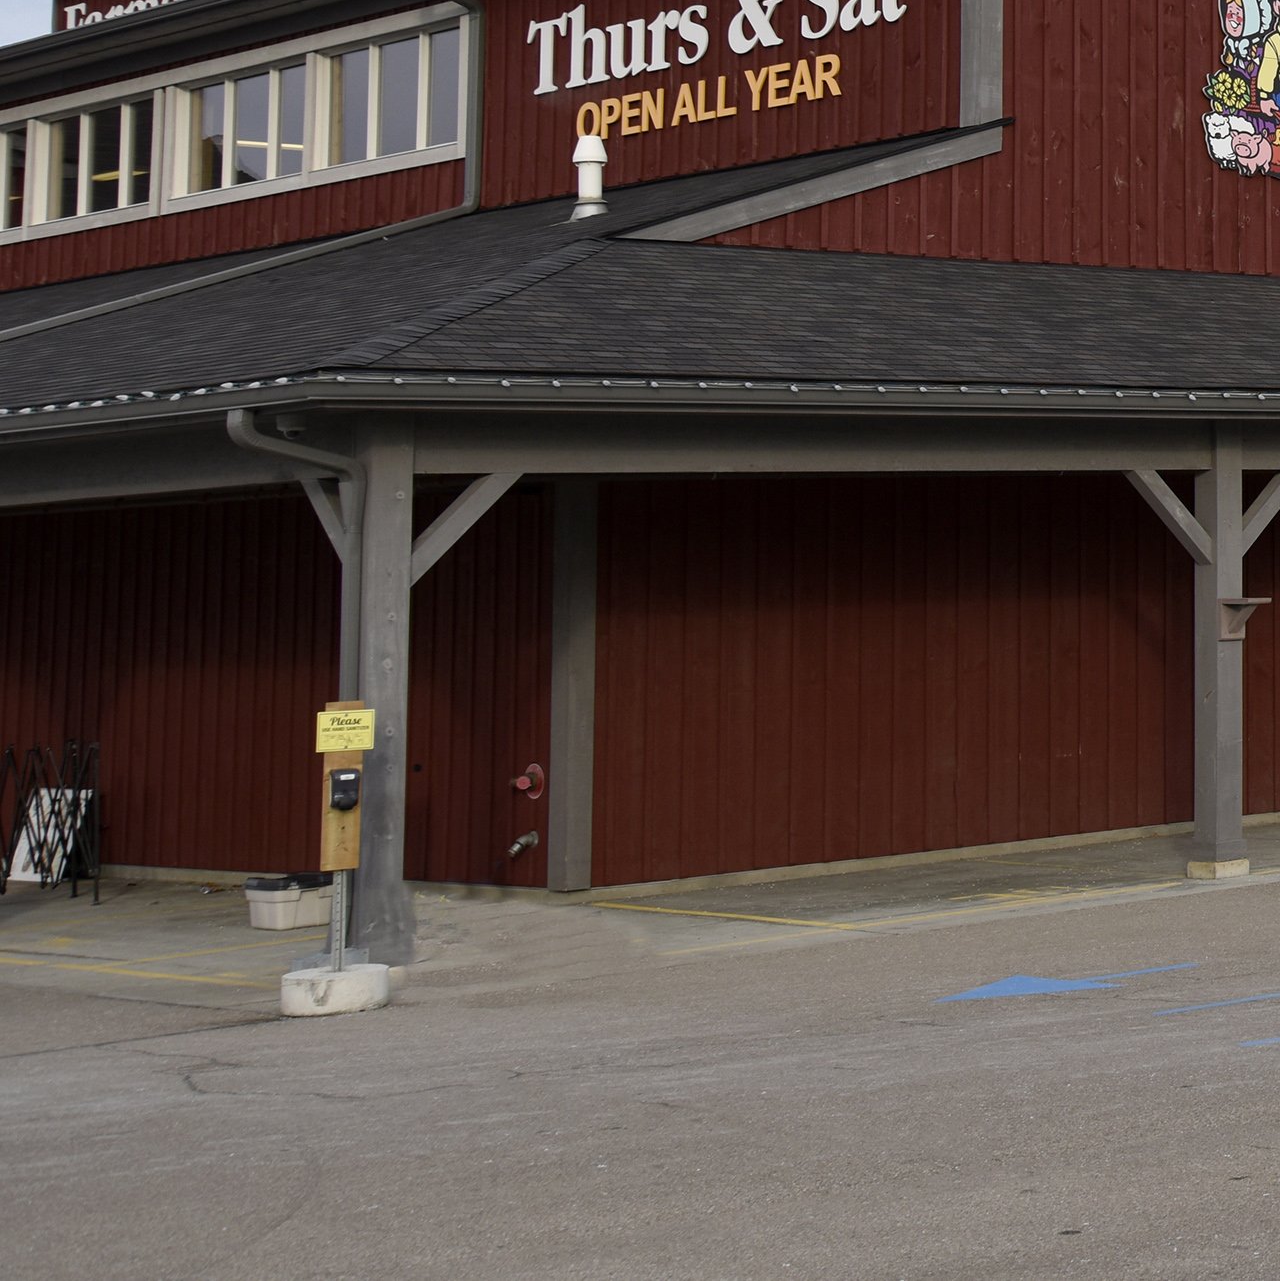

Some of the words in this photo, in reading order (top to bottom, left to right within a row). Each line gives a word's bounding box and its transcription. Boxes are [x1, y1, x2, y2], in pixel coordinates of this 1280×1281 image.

[526, 3, 710, 96] Thurs
[576, 87, 665, 140] OPEN
[670, 75, 737, 127] ALL
[744, 53, 843, 112] YEAR
[329, 716, 362, 726] Please
